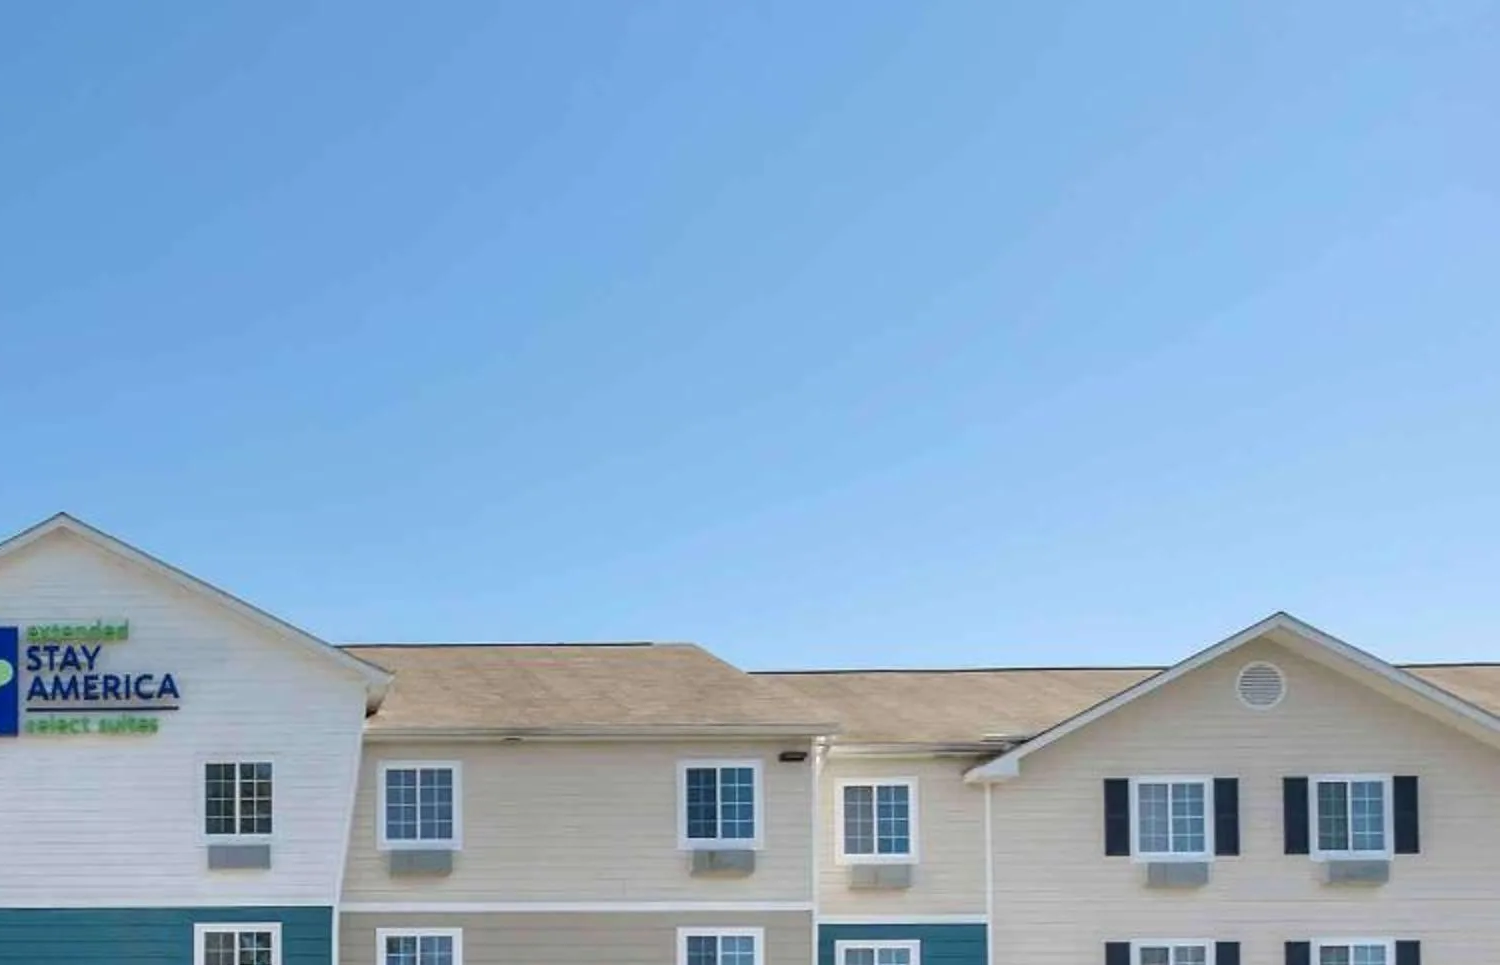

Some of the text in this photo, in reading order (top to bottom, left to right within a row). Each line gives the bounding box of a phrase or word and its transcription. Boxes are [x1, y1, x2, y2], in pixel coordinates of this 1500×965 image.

[26, 619, 129, 641] extended
[26, 645, 102, 671] STAY
[26, 674, 180, 701] AMERICA
[25, 713, 159, 734] select suites
